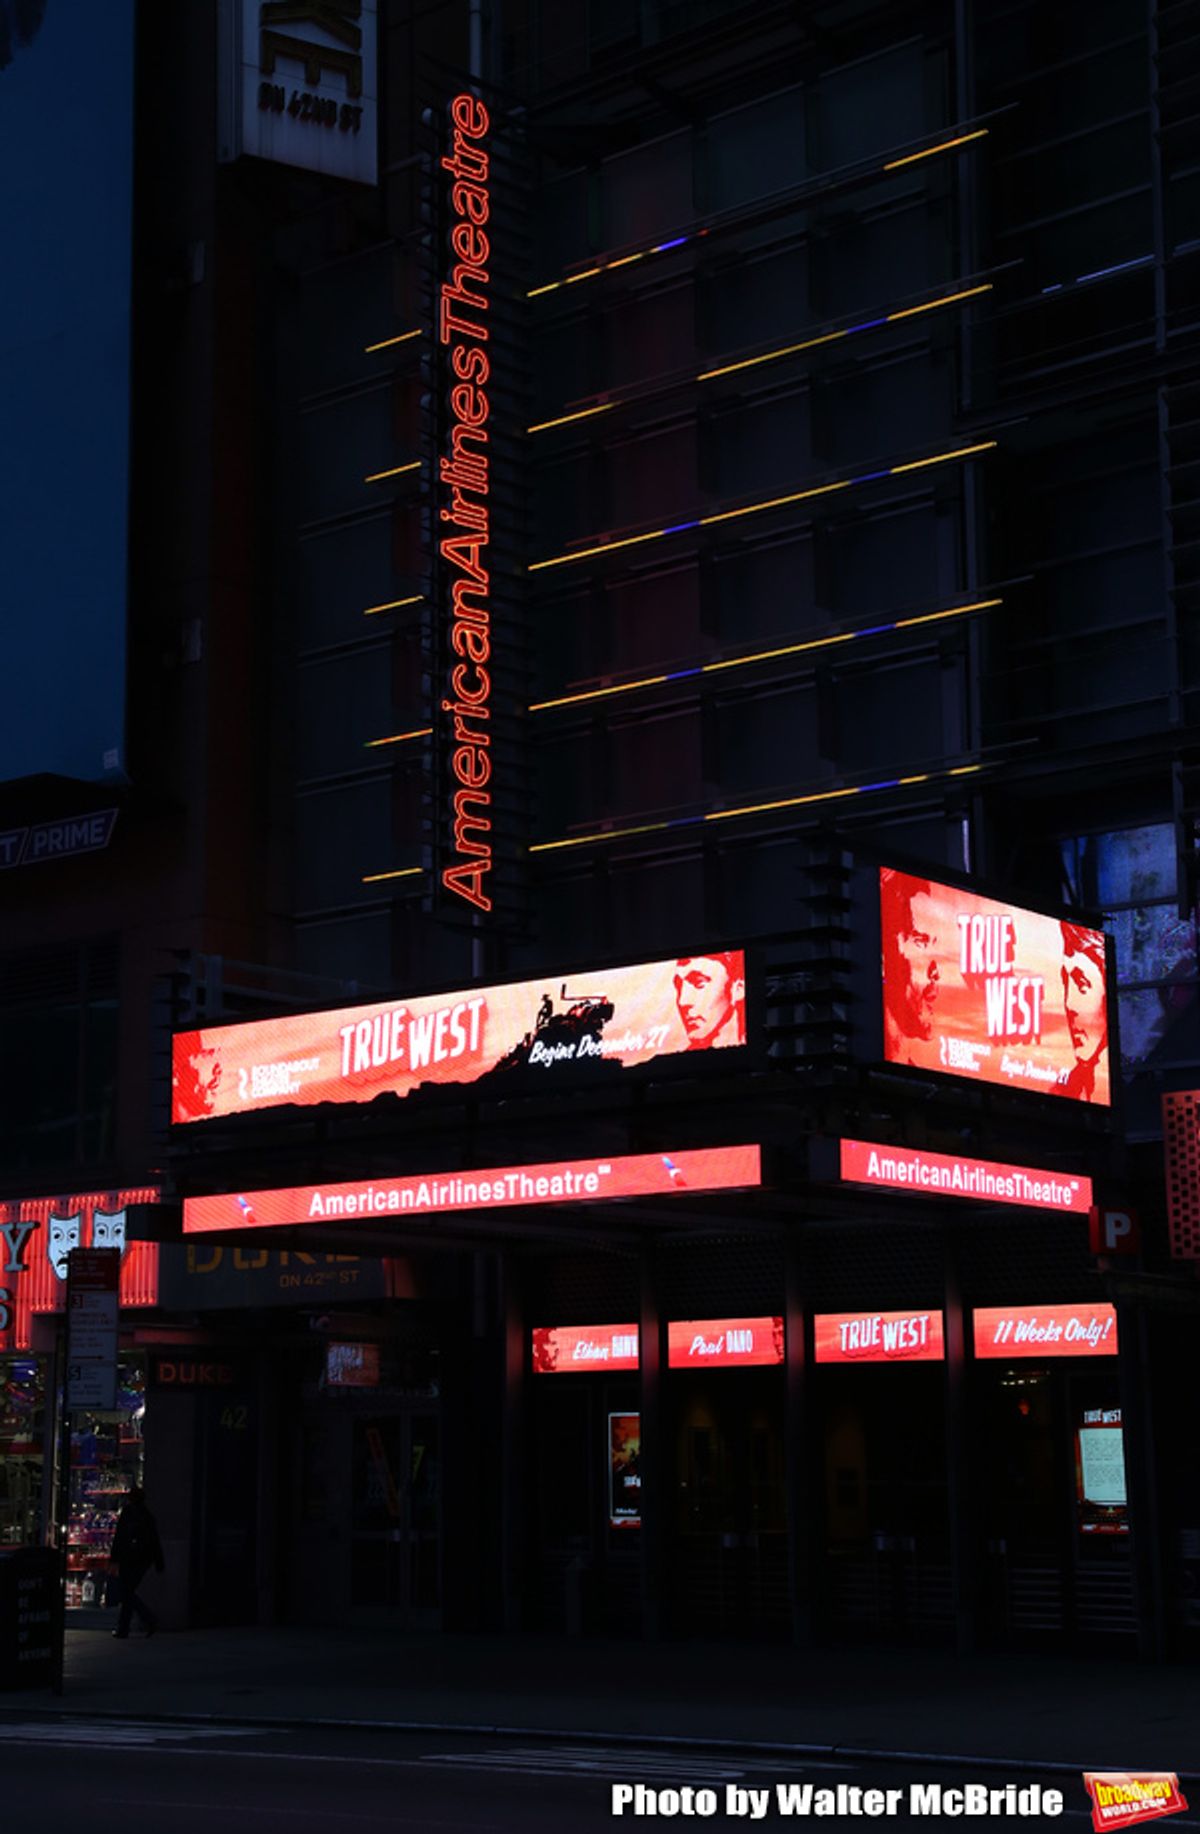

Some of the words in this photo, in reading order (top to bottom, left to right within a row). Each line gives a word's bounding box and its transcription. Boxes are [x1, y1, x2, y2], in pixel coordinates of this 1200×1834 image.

[441, 94, 491, 912] AmericanAirlinesTheatre
[32, 816, 106, 857] PRIME
[957, 914, 1013, 974] TRUE
[985, 977, 1043, 1037] WEST
[339, 1007, 407, 1077] TRUE
[408, 998, 484, 1072] WEST
[528, 1040, 576, 1068] Begins
[644, 1024, 670, 1049] 27
[1104, 1211, 1131, 1249] P
[279, 1274, 301, 1289] ON
[339, 1269, 361, 1284] ST
[689, 1333, 724, 1356] Paul
[840, 1316, 882, 1351] TRUE
[883, 1315, 929, 1351] WEST
[1014, 1318, 1063, 1344] Weeks
[1065, 1317, 1113, 1347] Only!
[158, 1362, 233, 1385] DUKE
